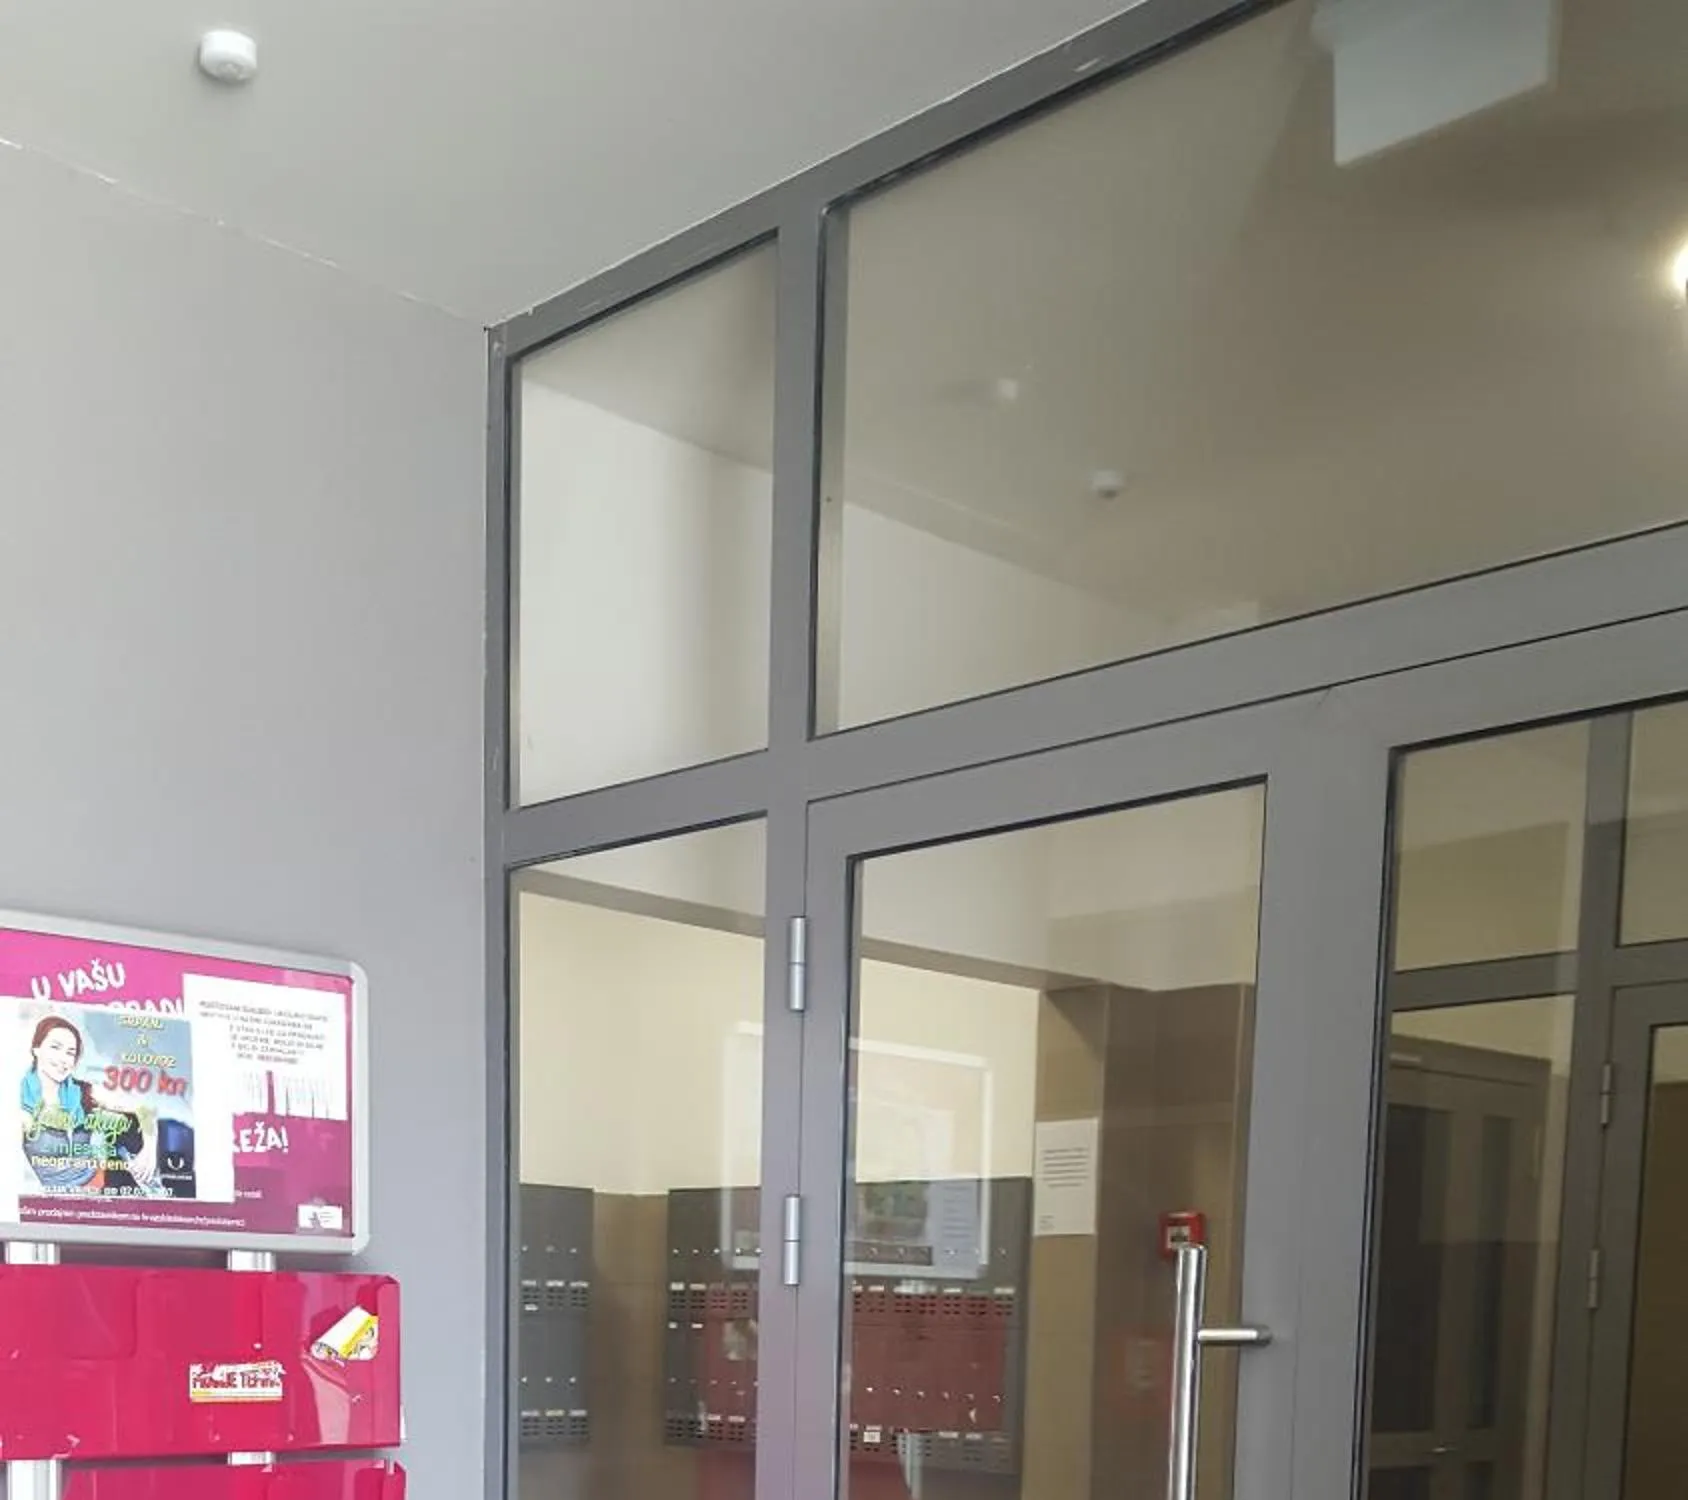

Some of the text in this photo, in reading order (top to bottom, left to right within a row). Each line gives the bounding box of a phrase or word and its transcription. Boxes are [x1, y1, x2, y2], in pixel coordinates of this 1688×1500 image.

[31, 957, 126, 1001] U VAŠU
[103, 1065, 153, 1093] 300
